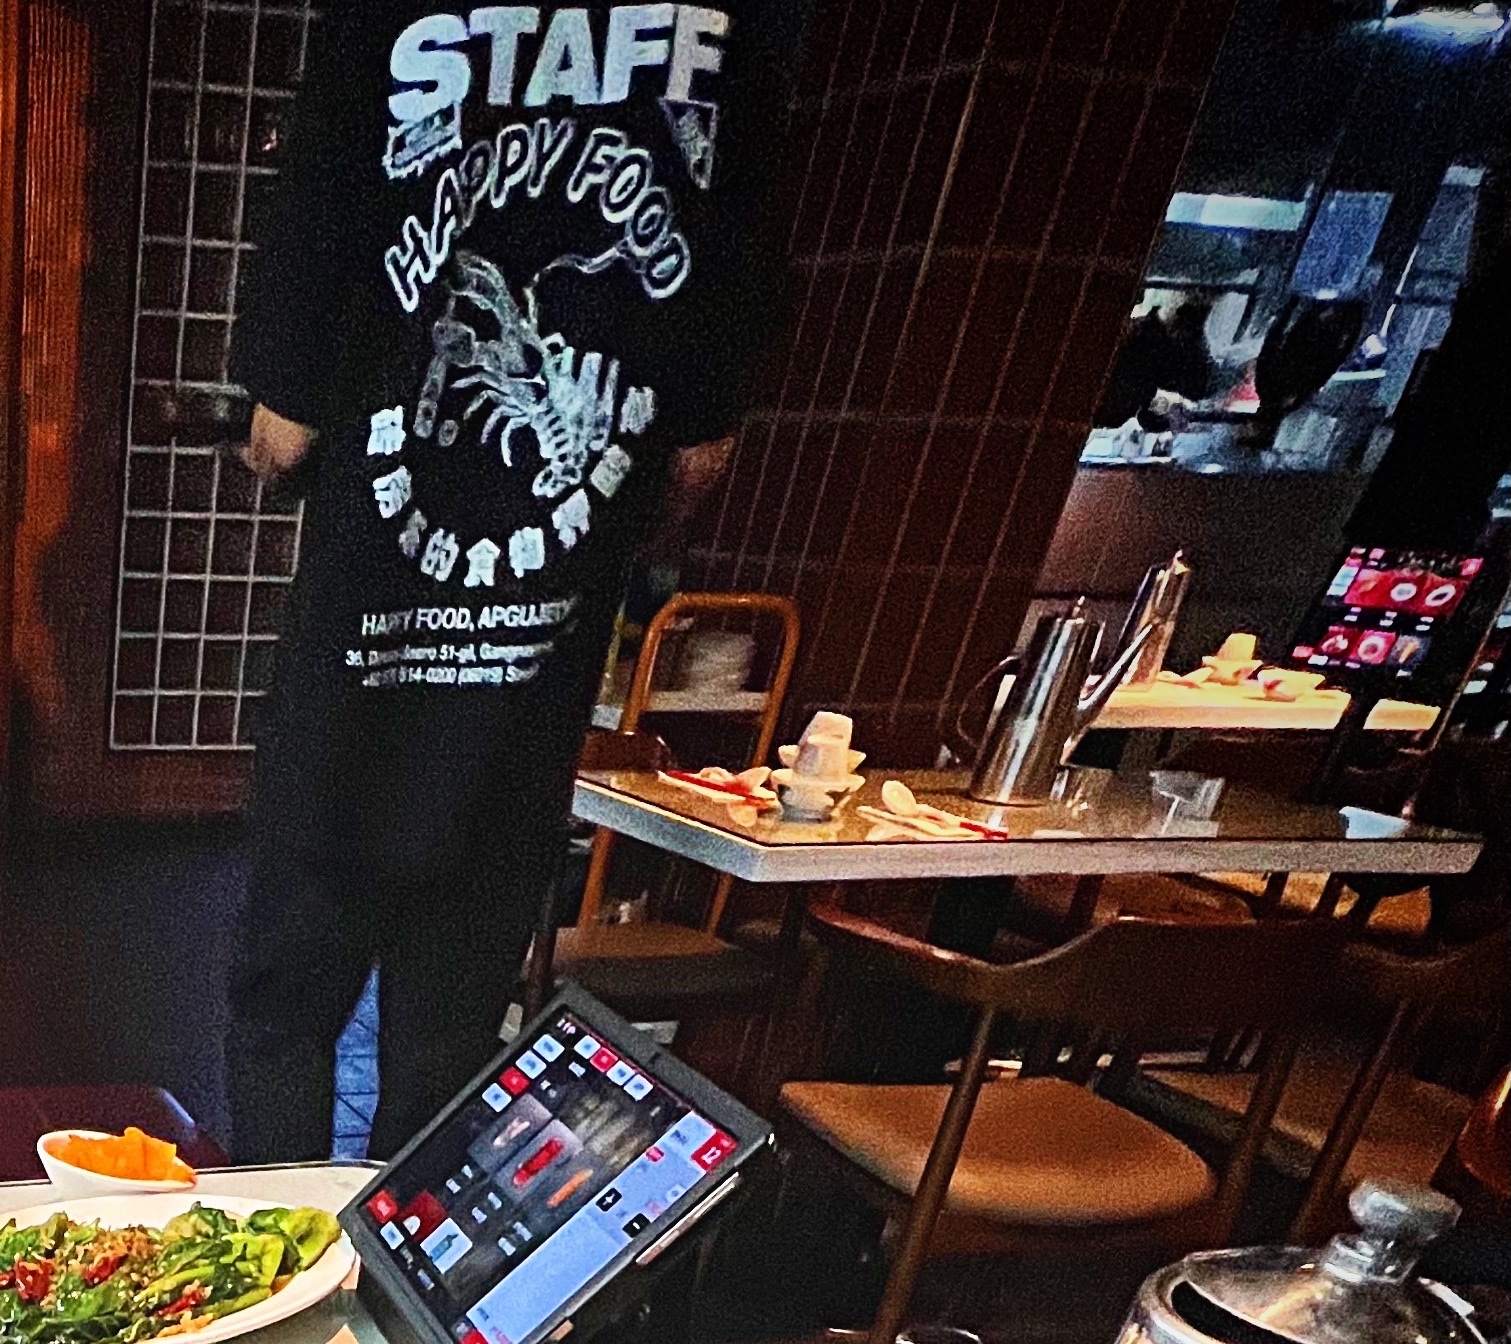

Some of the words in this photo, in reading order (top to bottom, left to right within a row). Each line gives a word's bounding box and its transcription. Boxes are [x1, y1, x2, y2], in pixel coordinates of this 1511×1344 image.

[388, 3, 730, 124] STAFF
[384, 117, 578, 313] HAPPY
[566, 127, 693, 300] FOOD
[415, 606, 475, 632] FOOD,
